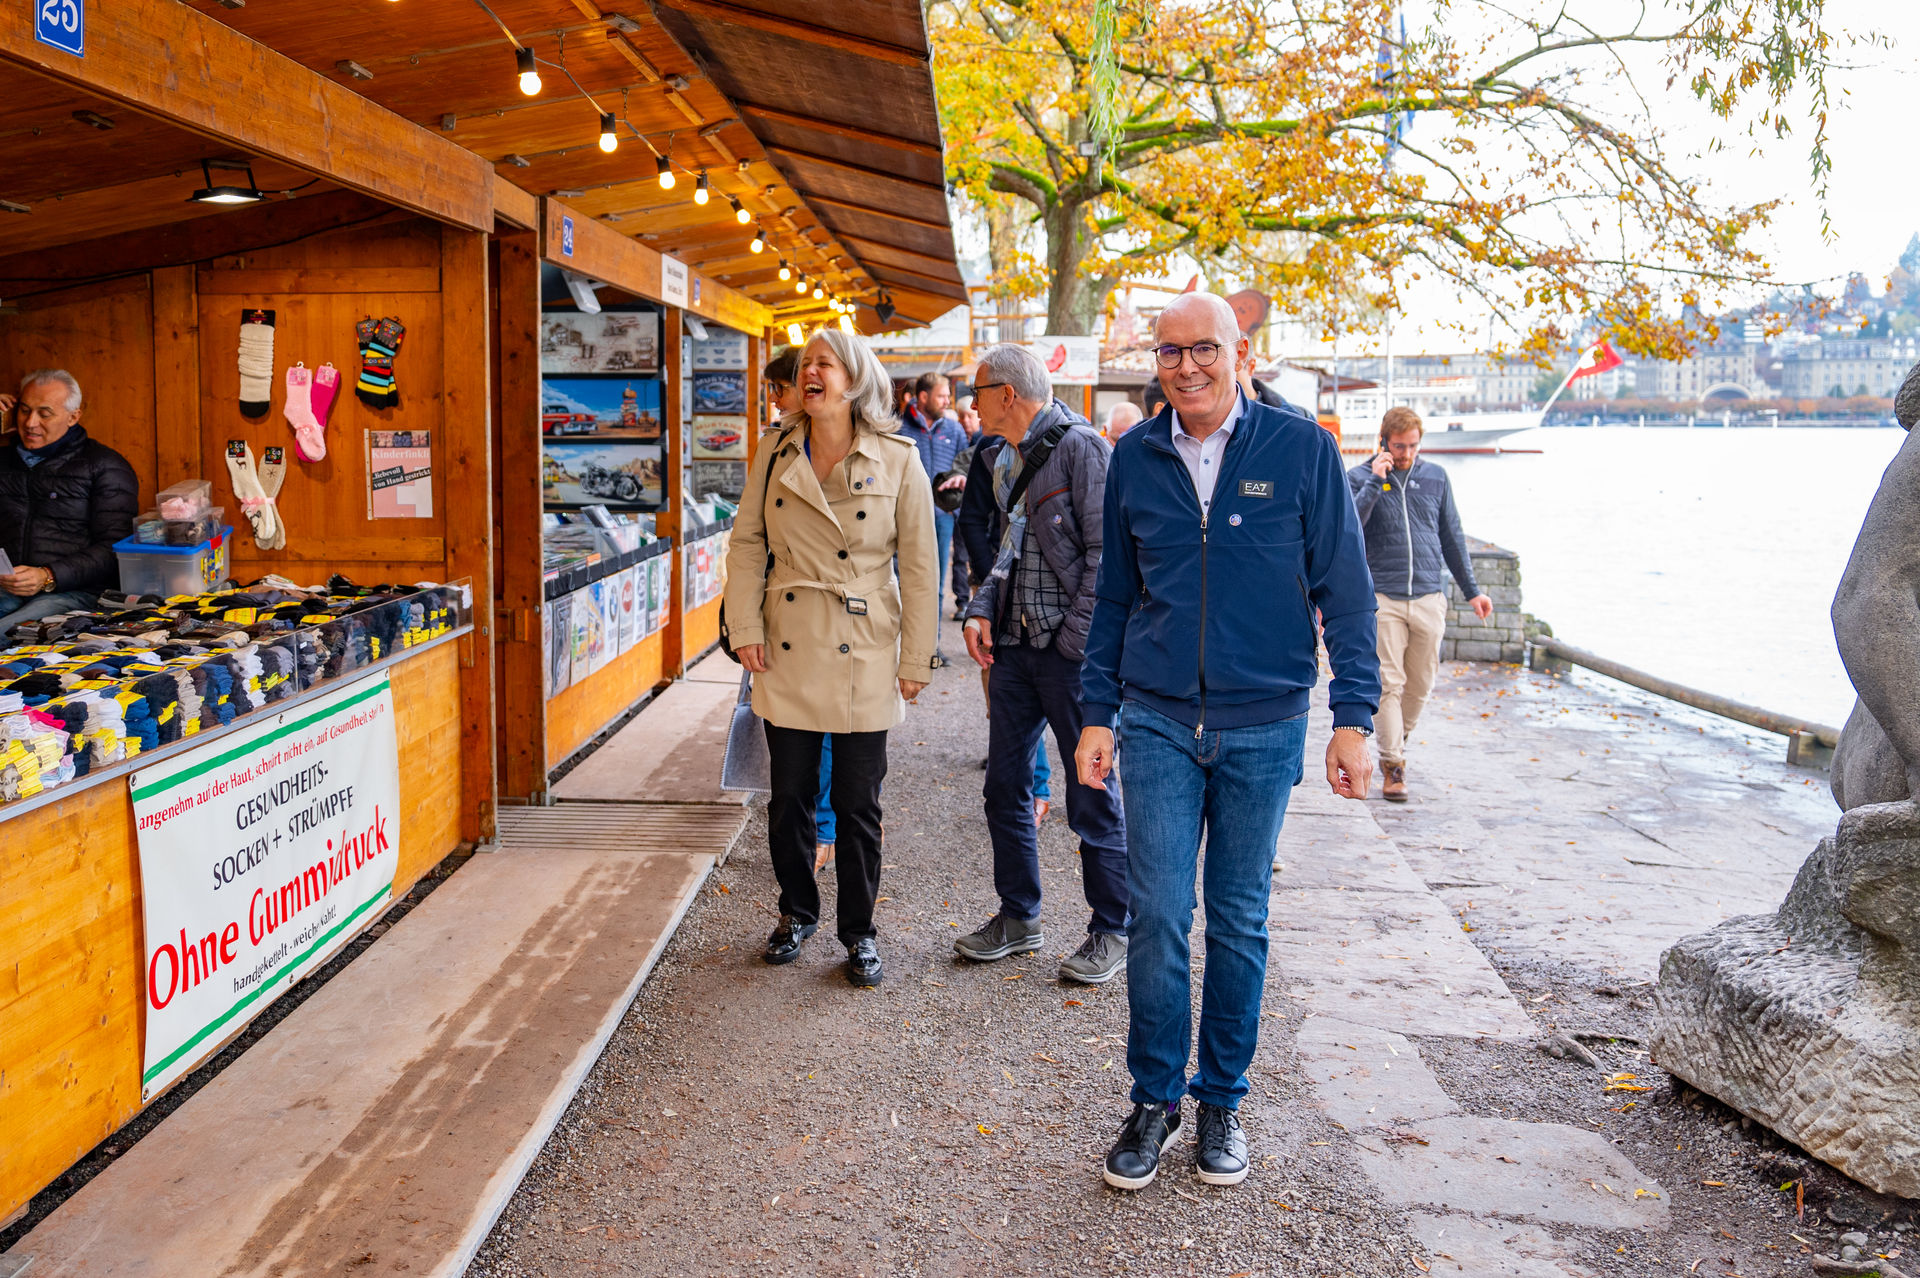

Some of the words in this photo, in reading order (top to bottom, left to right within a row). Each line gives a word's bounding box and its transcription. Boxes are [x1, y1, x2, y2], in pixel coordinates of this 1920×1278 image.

[42, 0, 79, 33] 25
[564, 224, 573, 249] 24
[1245, 482, 1268, 493] EA7
[139, 796, 194, 831] angenehm
[196, 784, 211, 806] auf
[212, 779, 230, 798] der
[230, 767, 255, 790] Haut,
[283, 742, 303, 763] nicht
[316, 727, 328, 746] auf
[329, 711, 369, 740] Gesundheit
[236, 760, 329, 830] GESUNDHEITS-
[213, 833, 269, 891] SOCKEN
[288, 786, 353, 842] STRÜMPFE
[148, 921, 239, 1011] Ohne
[249, 804, 389, 947] Gummidruck
[233, 942, 288, 994] handgekettelt
